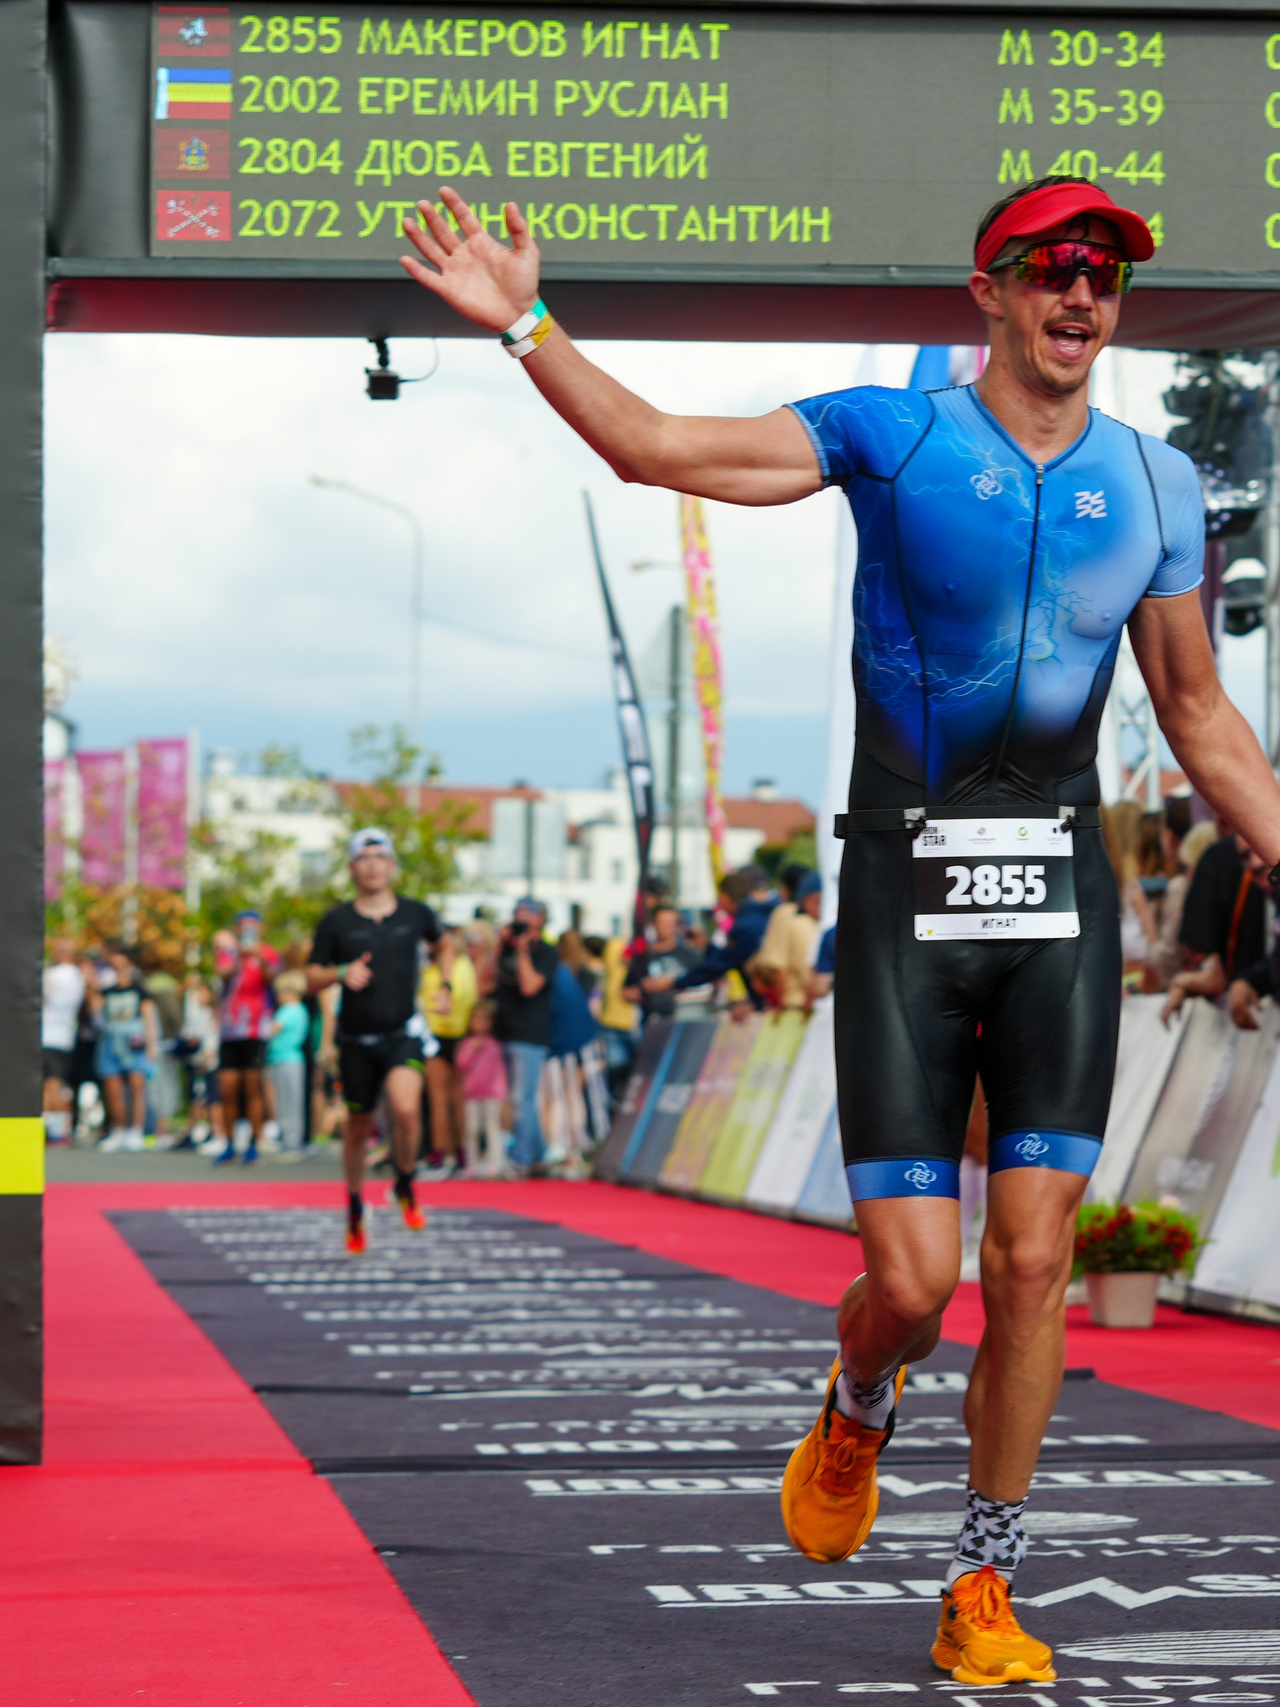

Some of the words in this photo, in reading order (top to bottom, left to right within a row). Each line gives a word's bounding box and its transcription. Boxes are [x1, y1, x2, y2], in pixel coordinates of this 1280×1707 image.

[239, 16, 343, 54] 2855
[357, 18, 568, 58] МАКЕРОВ
[582, 21, 730, 60] ИГНАТ
[1049, 30, 1166, 68] 30-34
[239, 75, 342, 114] 2002
[358, 76, 539, 116] ЕРЕМИН
[554, 79, 729, 119] РУСЛАН
[1050, 89, 1165, 126] 35-39
[239, 138, 344, 175] 2804
[355, 138, 493, 186] ДЮБА
[507, 134, 708, 179] ЕВГЕНИЙ
[1047, 150, 1166, 186] 40-44
[239, 200, 343, 238] 2072
[526, 202, 832, 243] КОНСТАНТИН
[945, 864, 1048, 906] 2855
